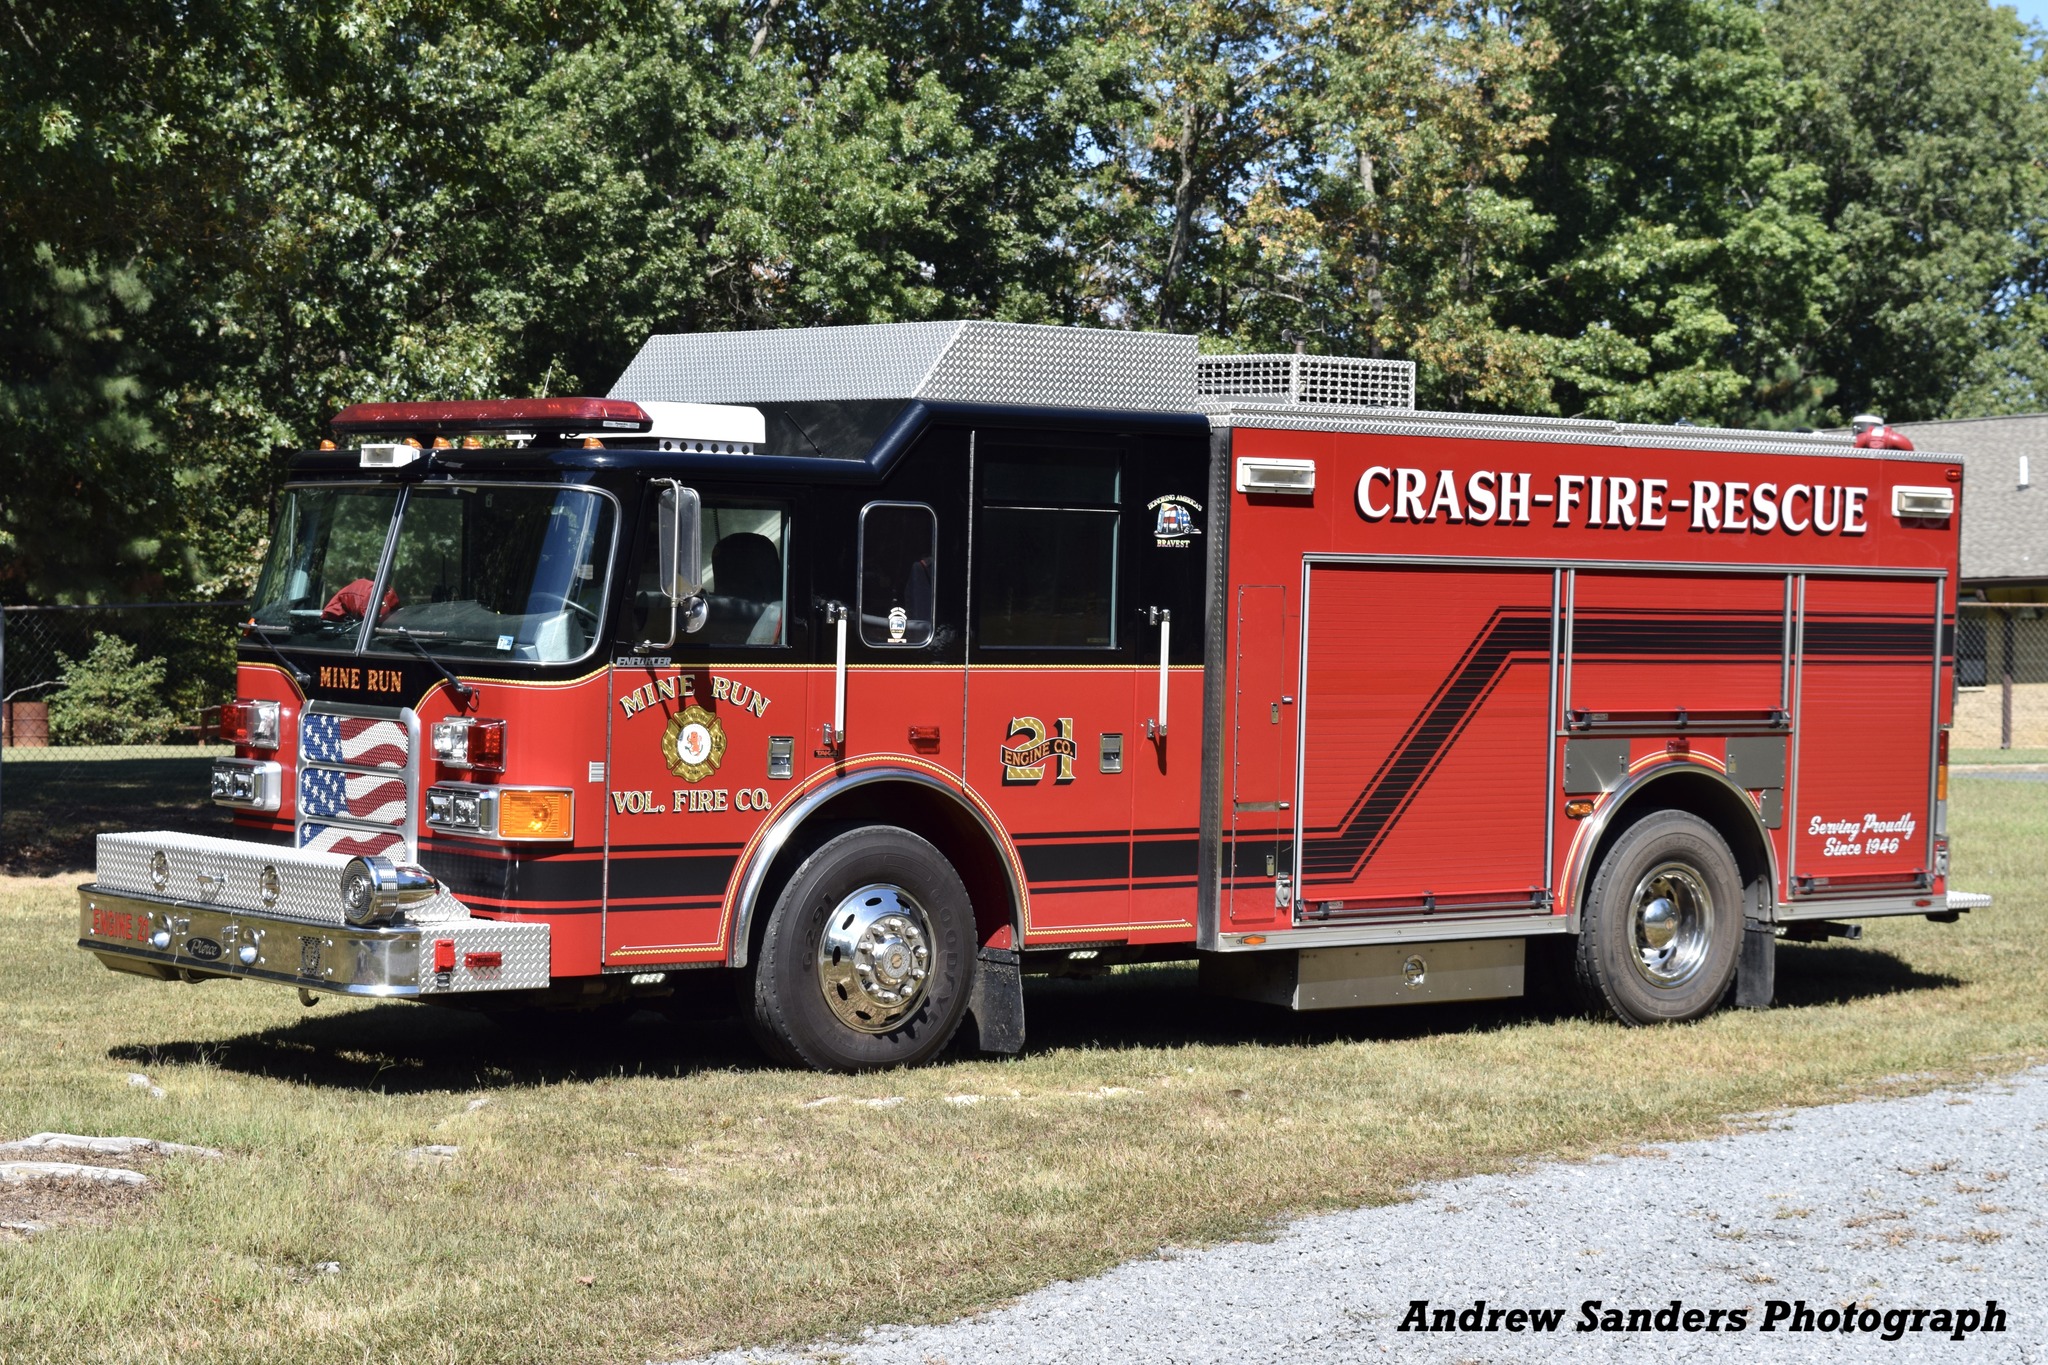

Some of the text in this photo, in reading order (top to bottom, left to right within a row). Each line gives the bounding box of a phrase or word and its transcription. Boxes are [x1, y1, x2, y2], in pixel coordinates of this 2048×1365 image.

[1354, 466, 1868, 537] CRASH-FIRE-RESCUE
[1157, 539, 1190, 548] BRAVEST
[616, 656, 672, 668] ENFORCER
[320, 666, 402, 693] MINE RUN
[619, 674, 772, 719] MINE RUN
[1003, 717, 1077, 786] 21
[1004, 739, 1074, 766] ENGINE CO.
[612, 788, 772, 815] VOL. FIRE CO.
[1808, 812, 1916, 842] Serving Proudly
[1823, 837, 1900, 856] Since 1946
[93, 908, 149, 942] ENGINE 21
[191, 939, 218, 956] Pierce
